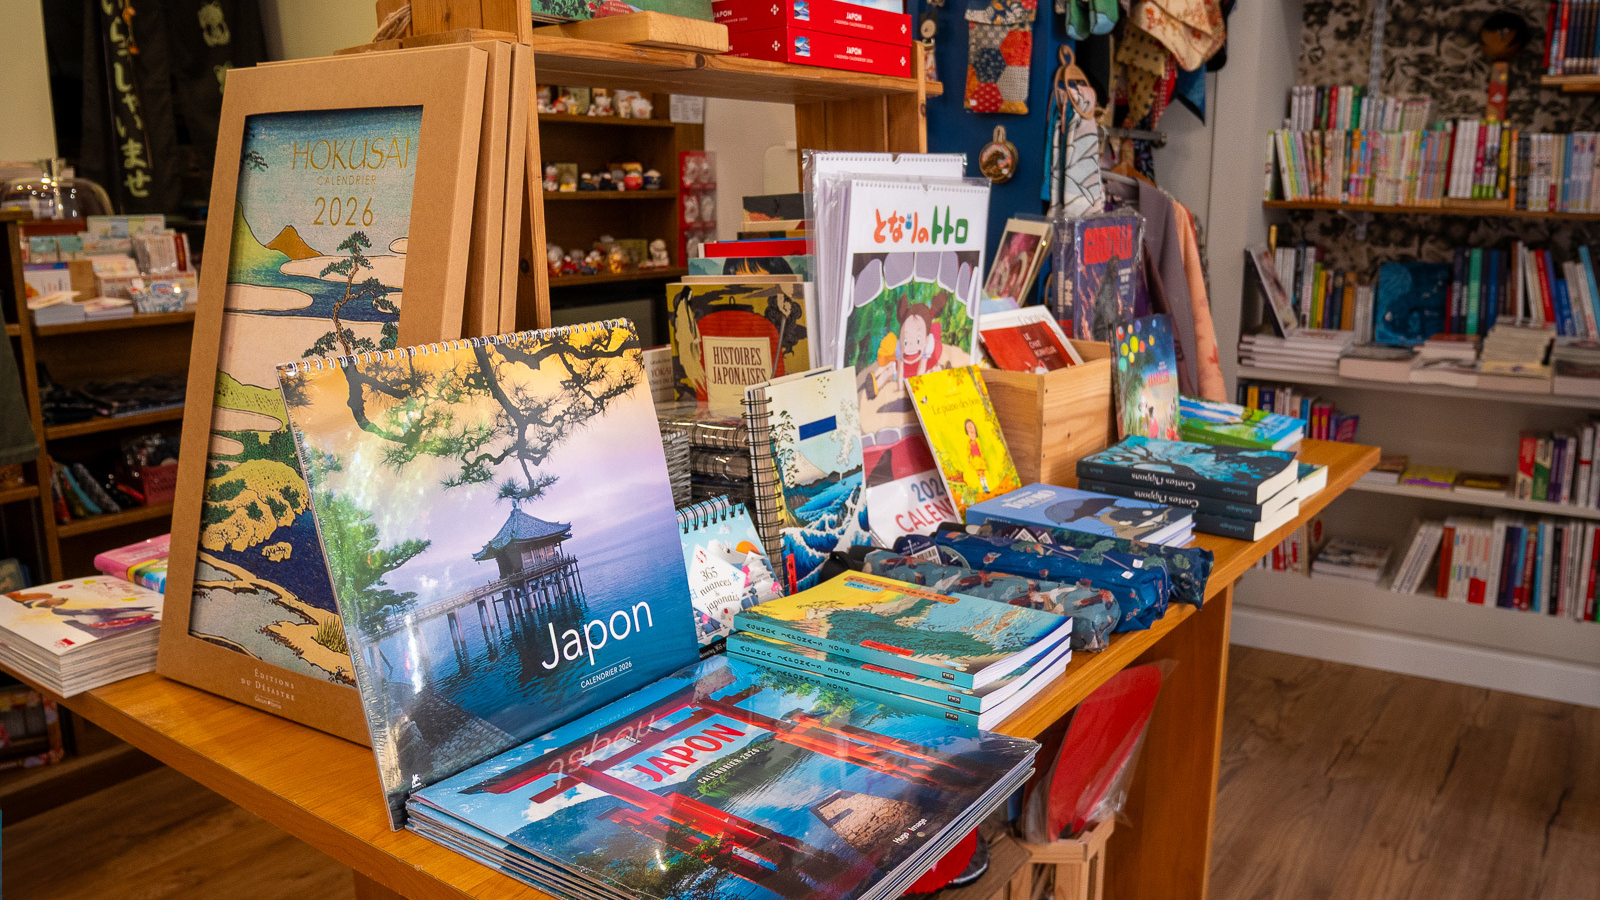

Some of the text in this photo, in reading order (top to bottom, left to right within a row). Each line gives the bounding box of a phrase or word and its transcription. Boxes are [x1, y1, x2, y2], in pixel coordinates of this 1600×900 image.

[846, 12, 863, 21] JAPON
[846, 46, 863, 55] JAPON
[291, 136, 410, 171] HOKUSAI
[316, 174, 377, 186] CALENDRIER
[312, 196, 374, 227] 2026
[873, 205, 969, 246] となりのトトロ
[1084, 224, 1132, 265] GODZILLA
[712, 346, 762, 366] HISTOIRES
[712, 366, 767, 386] JAPONAISES
[911, 477, 946, 502] 202
[1168, 478, 1195, 491] Contes
[1170, 496, 1199, 509] Contes
[700, 566, 718, 582] 365
[699, 579, 732, 596] nuances
[704, 591, 740, 614] japonais
[542, 601, 653, 670] Japon
[746, 623, 776, 635] AGENDA
[781, 633, 823, 647] JAPONAIS
[829, 644, 851, 654] 2026
[740, 646, 851, 677] AGENDA JAPONAIS 2026
[254, 668, 294, 689] ÉDITIONS
[580, 661, 633, 688] CALENDRIER 2026
[777, 670, 821, 685] JAPONAIS
[826, 682, 850, 693] 2026
[240, 678, 295, 701] DU DÉSASTRE
[631, 723, 746, 783] JAPON
[697, 748, 760, 784] CALENDRIER 2026
